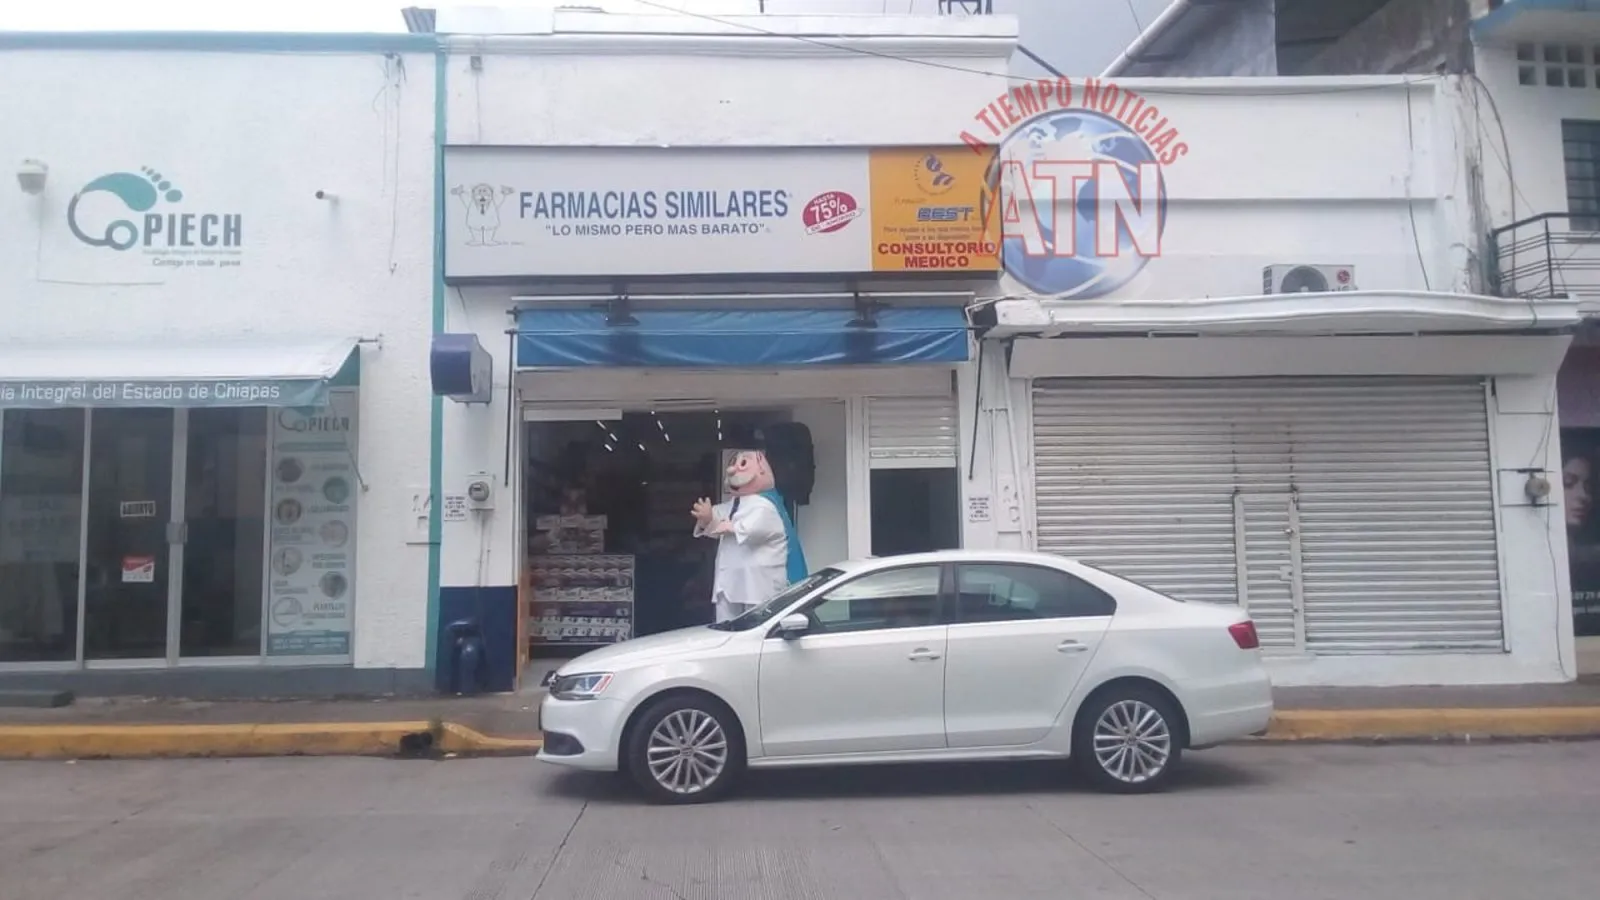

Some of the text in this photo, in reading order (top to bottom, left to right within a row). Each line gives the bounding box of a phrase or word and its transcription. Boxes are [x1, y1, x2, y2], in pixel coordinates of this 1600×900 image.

[519, 190, 788, 219] FARMACIAS SIMILARES
[809, 196, 848, 223] 75%
[917, 206, 974, 222] BEST
[143, 213, 242, 247] PIECH
[575, 224, 621, 236] MISMO
[625, 223, 664, 236] PERO
[667, 223, 698, 235] MAS
[878, 242, 996, 255] CONSULTORIO
[904, 256, 969, 268] MEDICO
[21, 383, 86, 403] Integral
[92, 383, 116, 400] del
[122, 383, 183, 400] Estado
[188, 383, 209, 399] de
[214, 382, 280, 401] Chiapas
